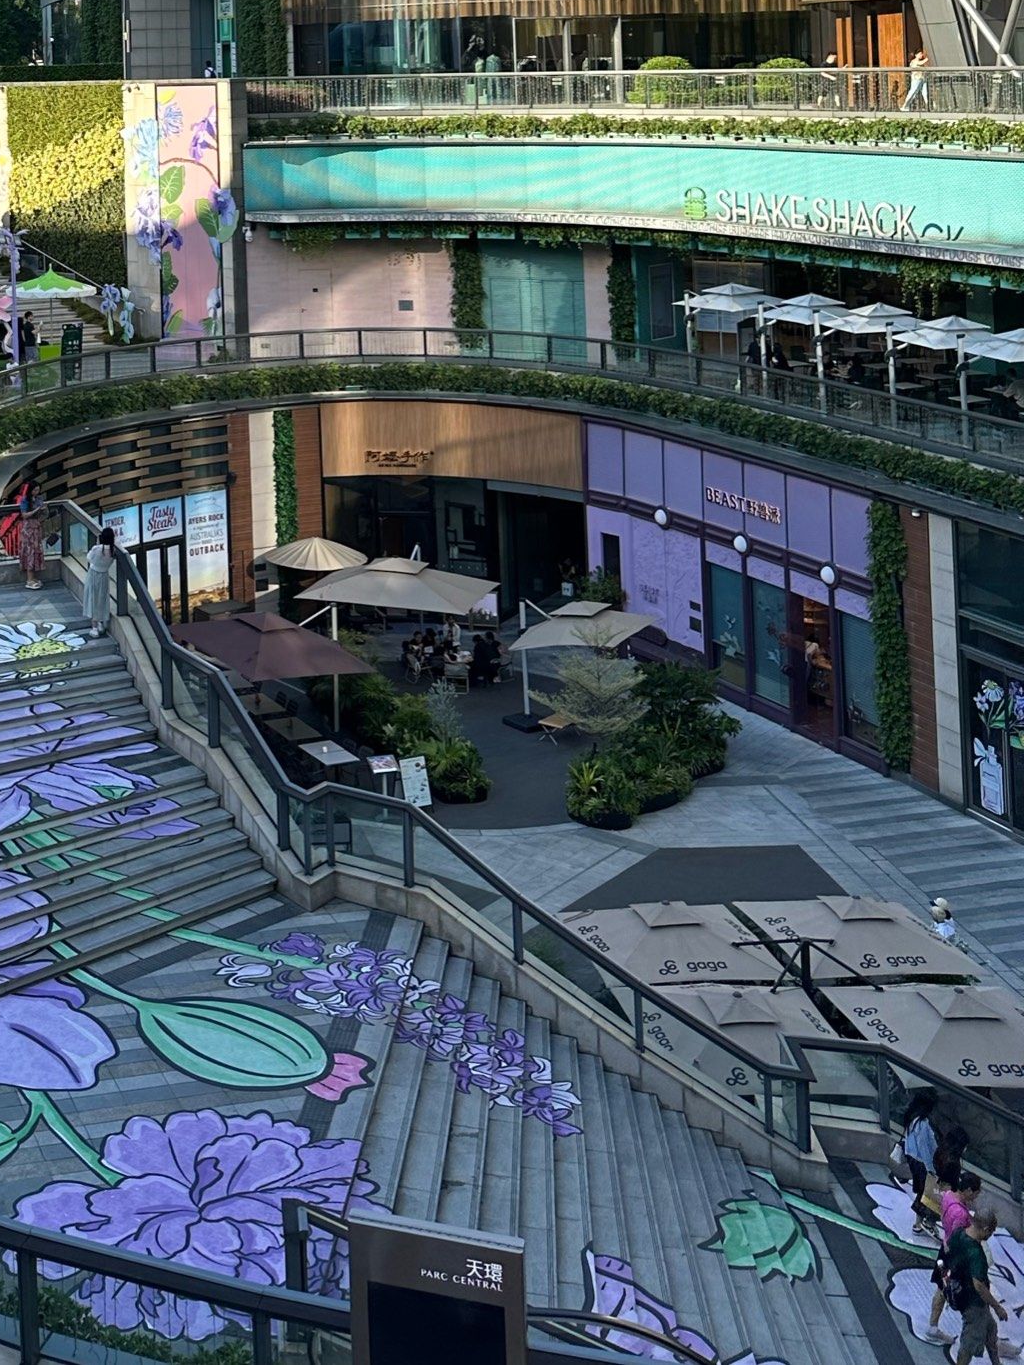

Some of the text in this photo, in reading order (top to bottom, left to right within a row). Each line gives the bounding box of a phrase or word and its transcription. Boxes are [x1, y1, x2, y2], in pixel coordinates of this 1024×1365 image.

[716, 189, 919, 242] SHAKE SHACK
[706, 486, 746, 512] BEAST
[150, 505, 175, 520] Tasty
[147, 517, 177, 532] Steaks
[189, 544, 225, 556] OUTBACK
[687, 960, 727, 973] gaga
[886, 955, 927, 967] gaga
[867, 1018, 899, 1043] gaga
[988, 1063, 1024, 1077] gag
[465, 1258, 503, 1283] 天環
[420, 1268, 503, 1292] PARC CENTRAL
